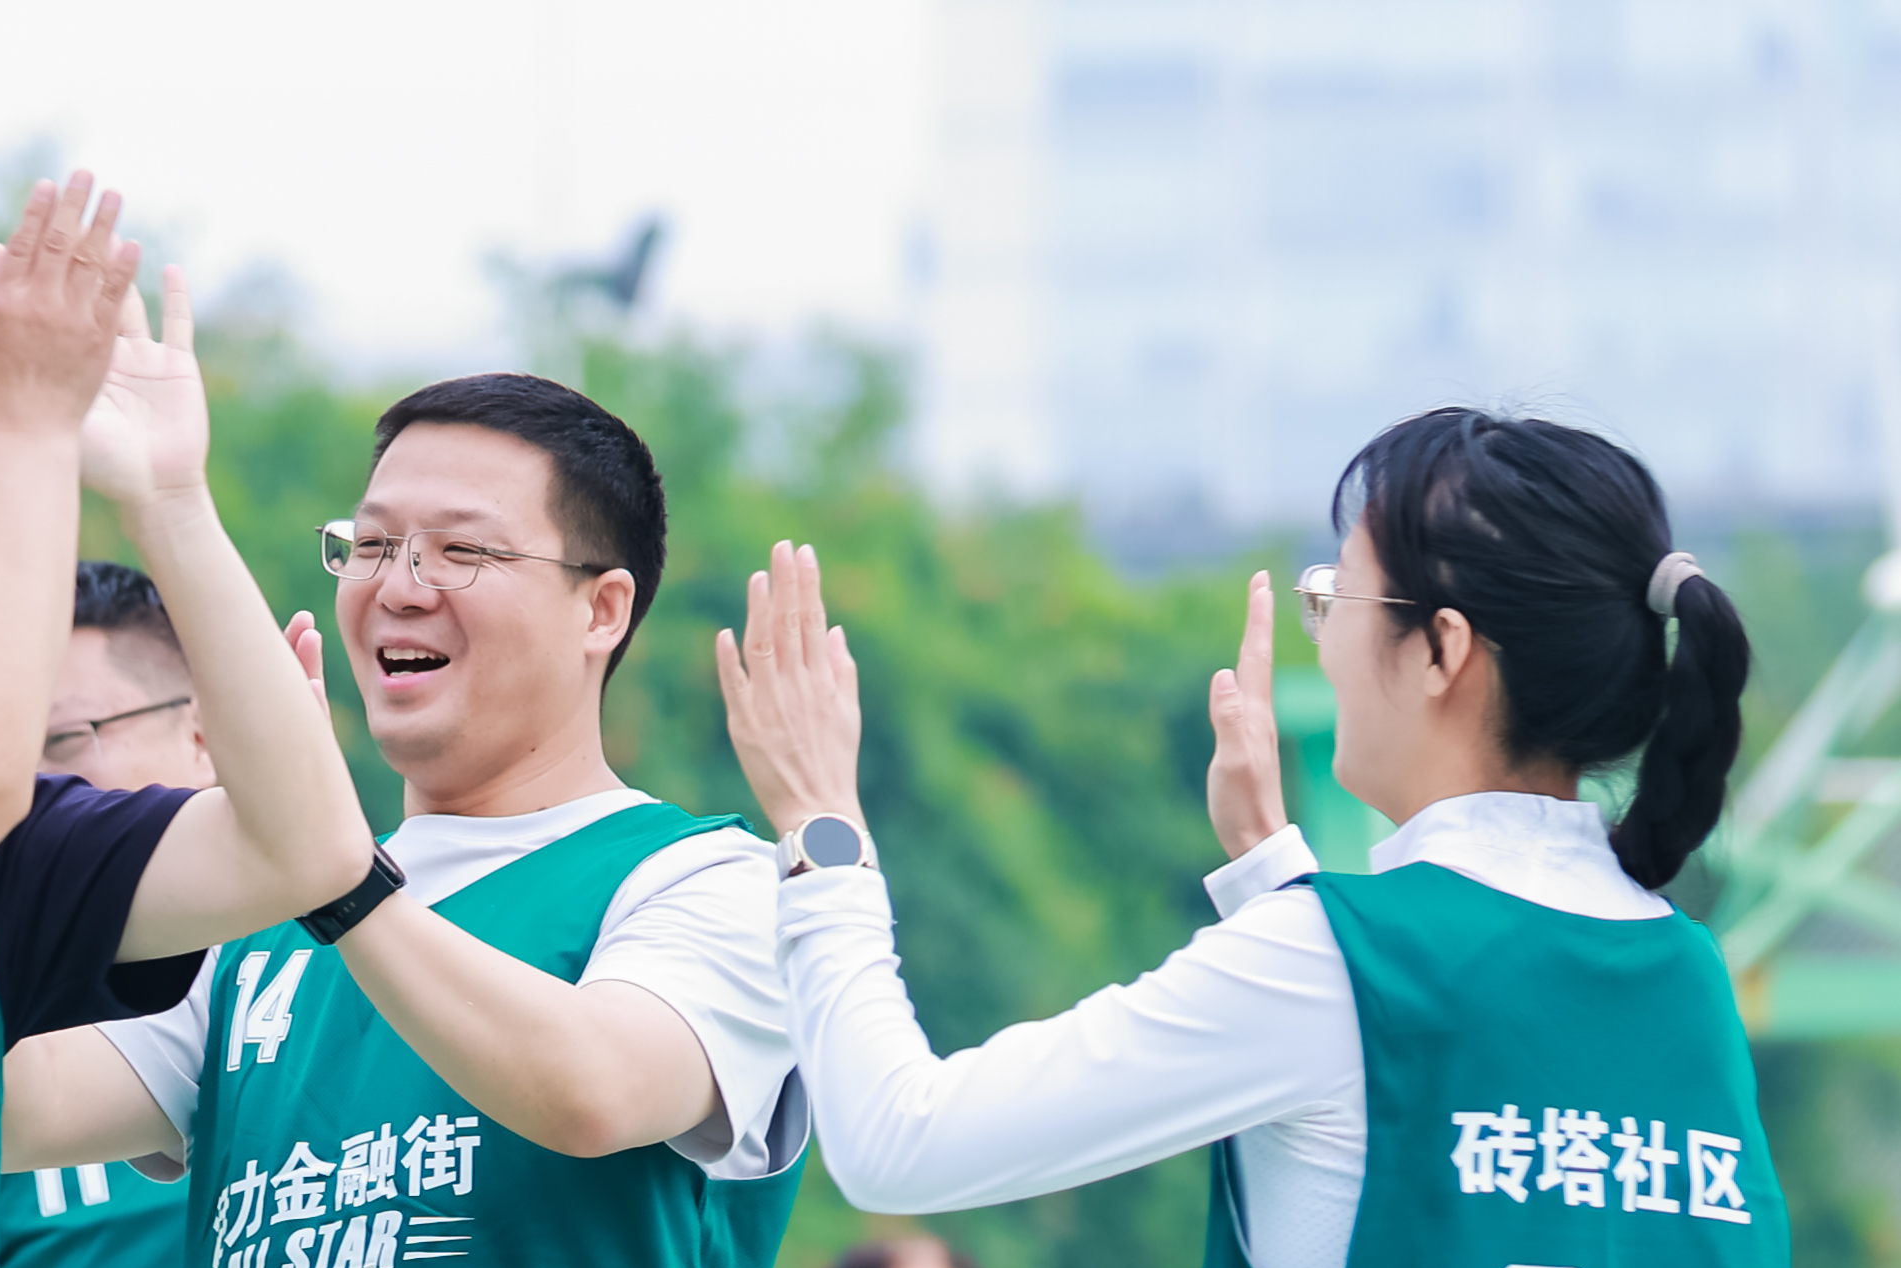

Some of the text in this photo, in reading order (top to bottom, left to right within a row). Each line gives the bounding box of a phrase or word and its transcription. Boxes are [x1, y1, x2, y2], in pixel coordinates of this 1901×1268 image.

[226, 949, 313, 1072] 14
[1450, 1104, 1752, 1225] 砖塔社区
